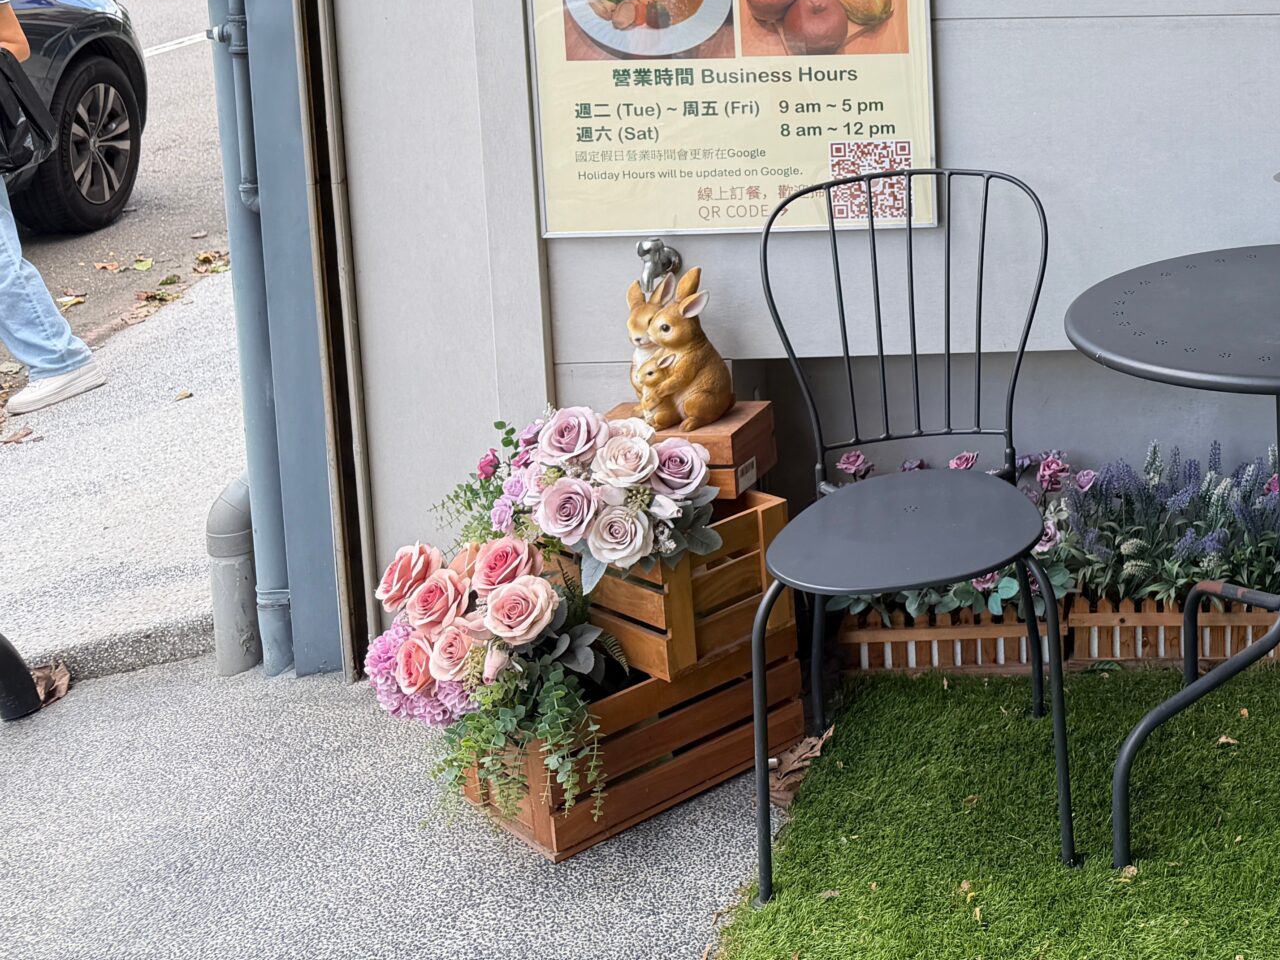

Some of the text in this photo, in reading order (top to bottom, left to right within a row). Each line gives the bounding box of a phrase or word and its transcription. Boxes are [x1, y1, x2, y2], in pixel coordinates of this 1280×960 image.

[612, 66, 858, 88] 營業時間 Business Hours
[575, 102, 612, 119] 週二
[616, 102, 662, 121] (Tue)
[682, 100, 719, 118] 周五
[724, 100, 760, 118] (Fri)
[778, 99, 790, 114] 9
[794, 101, 822, 113] am
[841, 98, 853, 113] 5
[857, 100, 885, 116] pm
[576, 126, 660, 144] 週六 (Sat)
[780, 123, 791, 138] 8
[796, 125, 823, 137] am
[842, 121, 864, 136] 12
[869, 123, 896, 138] pm
[577, 166, 803, 182] Holiday Hours will be updated on Google.
[698, 204, 769, 221] QR CODE
